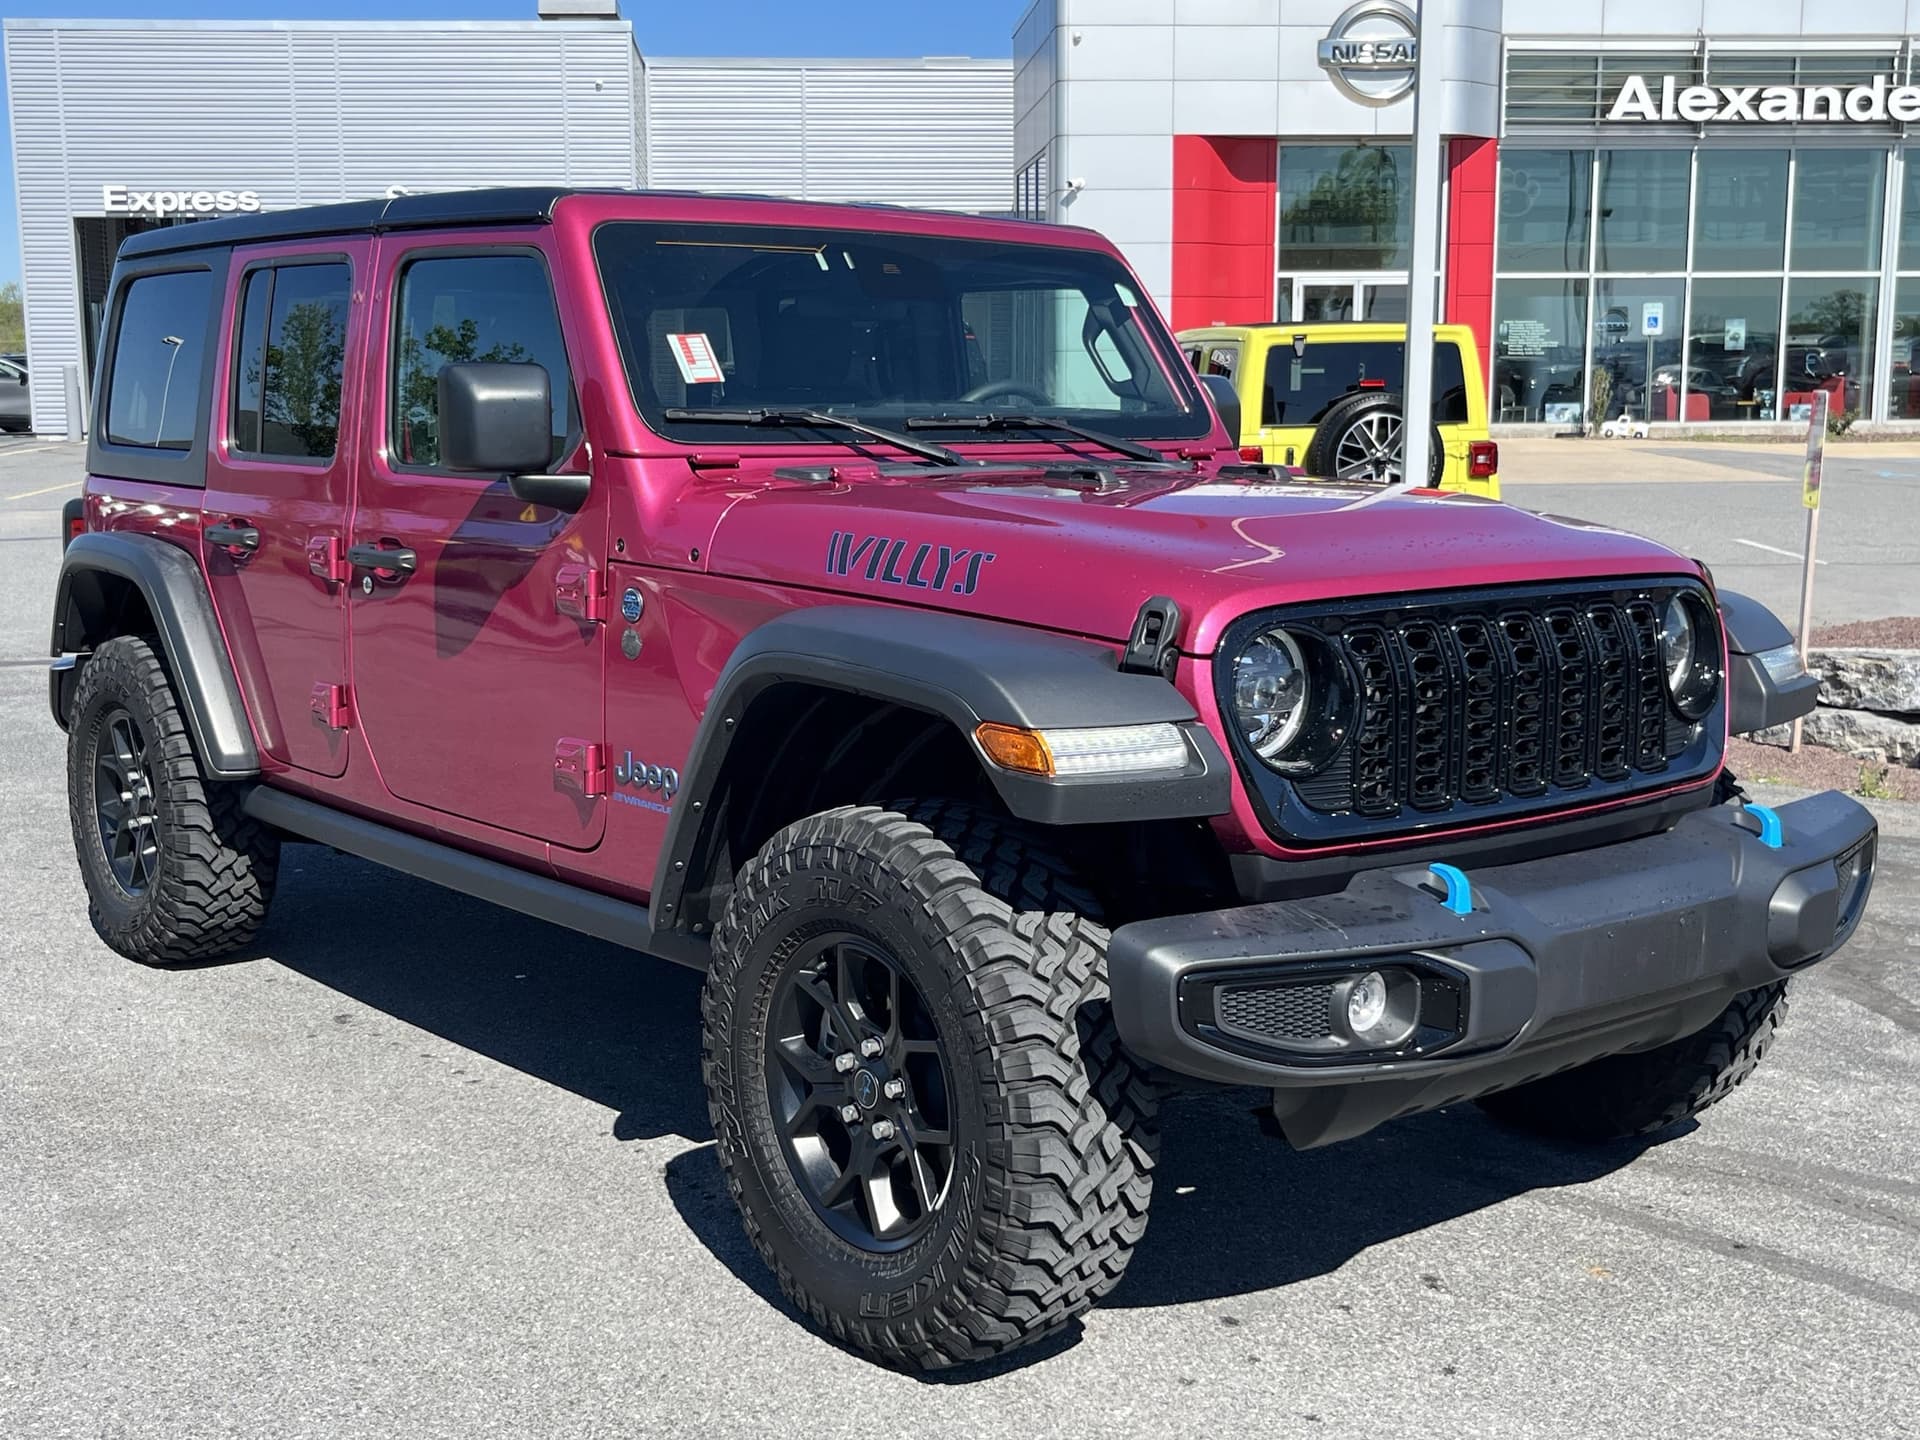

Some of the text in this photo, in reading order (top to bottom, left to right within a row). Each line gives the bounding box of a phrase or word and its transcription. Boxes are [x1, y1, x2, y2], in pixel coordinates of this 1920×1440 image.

[1606, 75, 1920, 121] Alexande
[102, 184, 261, 217] Express
[826, 530, 997, 596] WILLYS
[615, 750, 679, 800] Jeep
